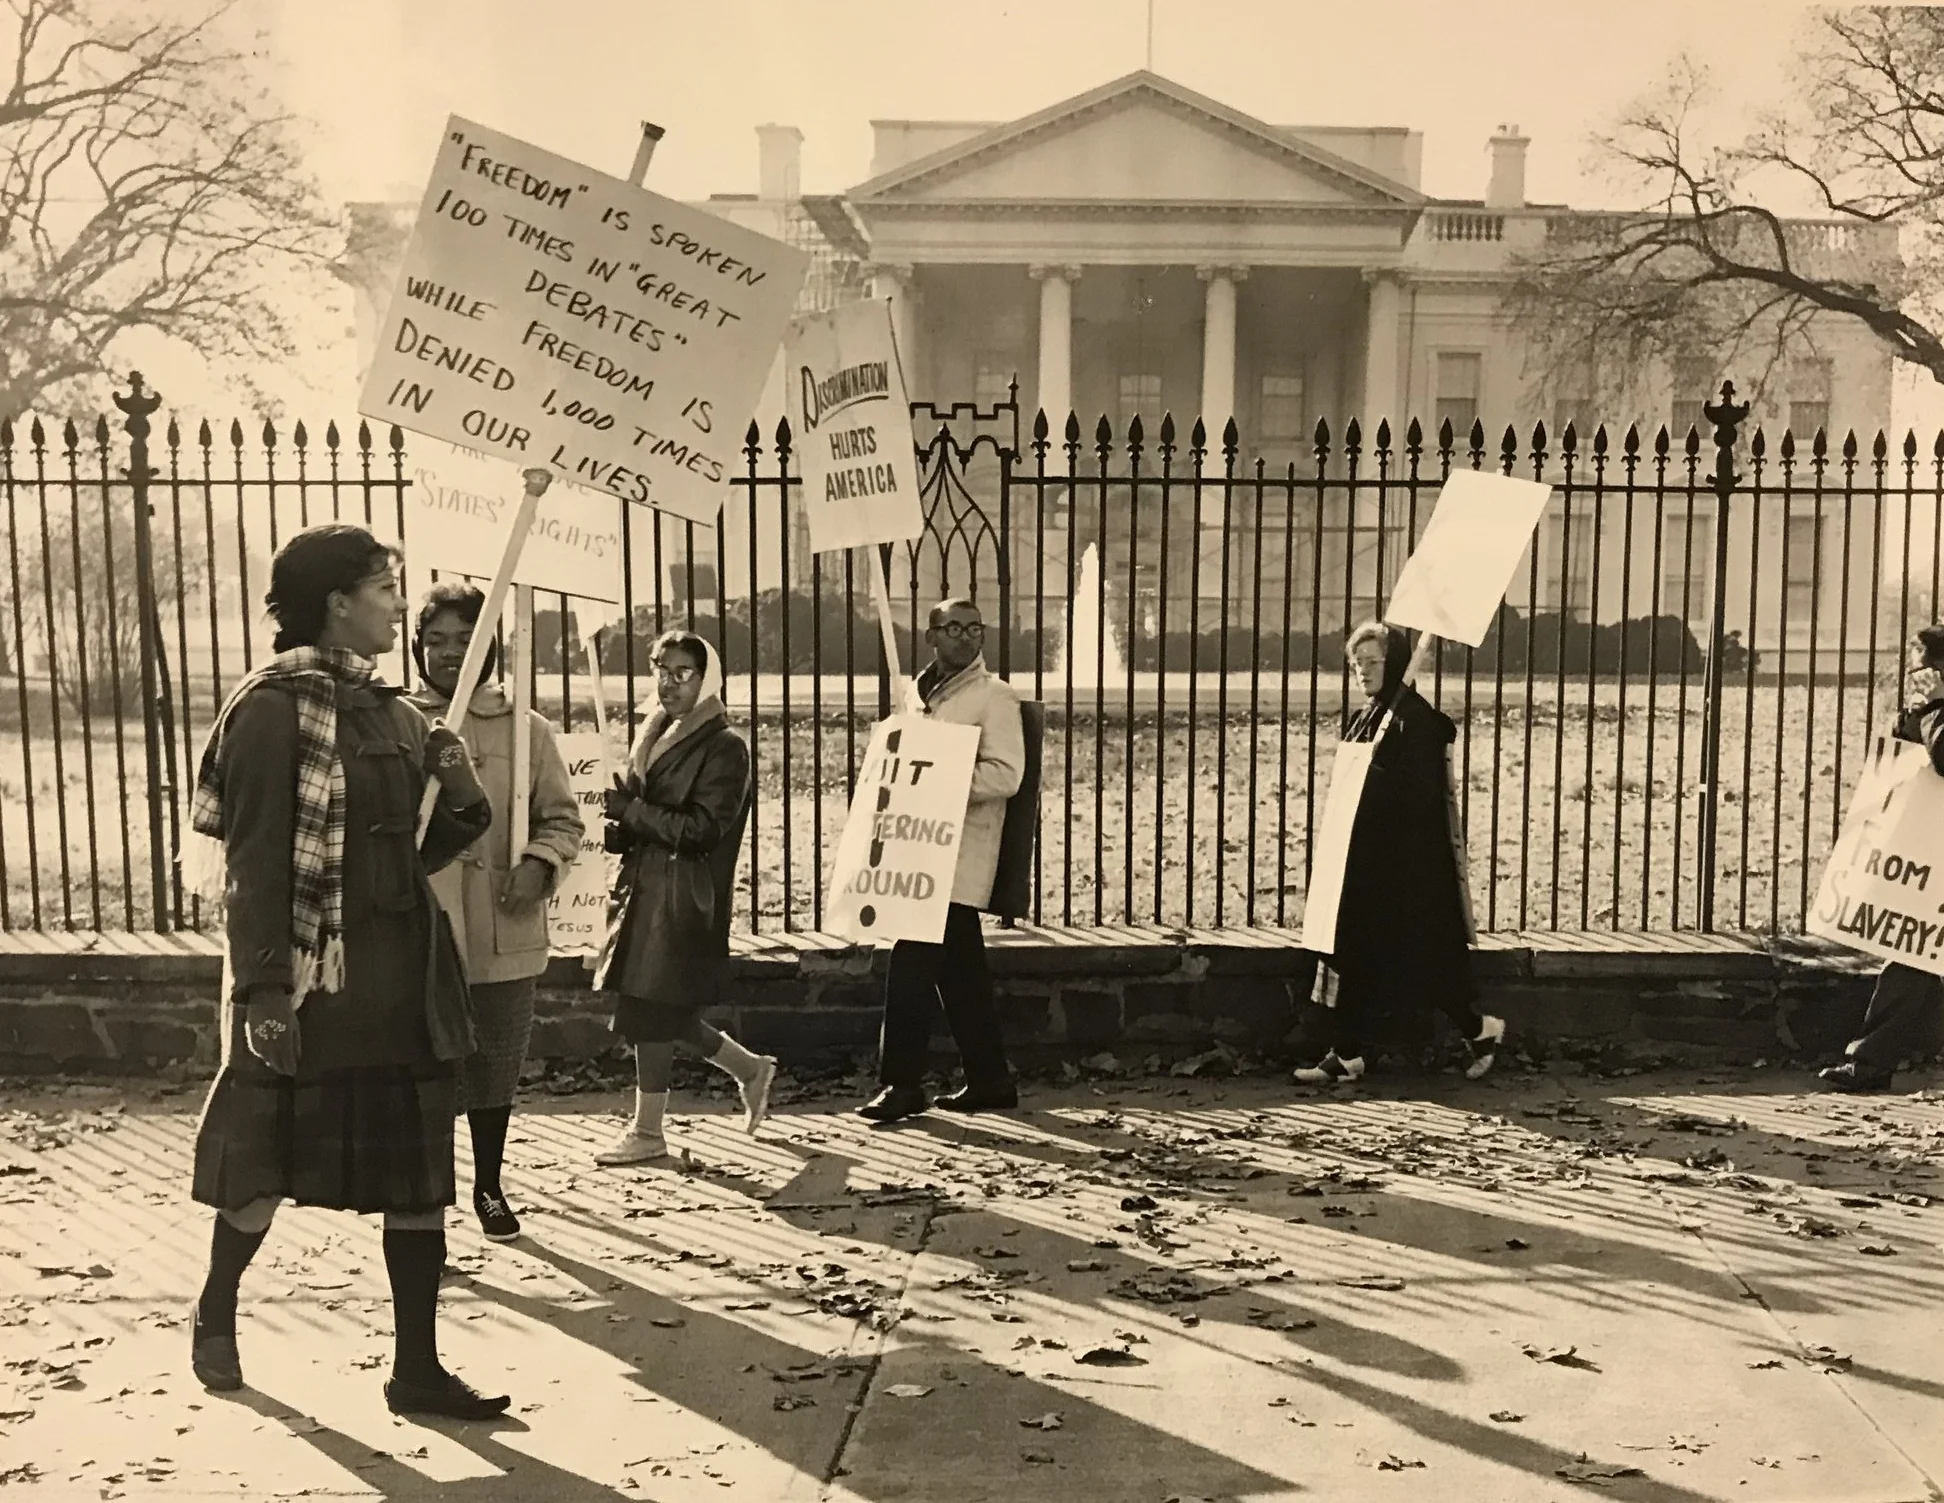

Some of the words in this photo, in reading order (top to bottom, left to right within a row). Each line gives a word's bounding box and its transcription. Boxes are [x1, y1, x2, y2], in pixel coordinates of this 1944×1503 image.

[450, 132, 589, 210] "FREEDOM"
[601, 207, 631, 232] IS
[650, 223, 767, 287] SPOKEN
[435, 189, 487, 227] 100
[503, 214, 576, 263] TIMES
[587, 257, 621, 283] IN
[628, 262, 742, 329] "GREAT
[525, 269, 688, 352] DEBATES"
[406, 276, 498, 322] WHILE
[522, 320, 655, 401] FREEDOM
[681, 397, 714, 434] IS
[394, 318, 516, 392] DENIED
[541, 388, 616, 431] 1,000
[632, 426, 725, 484] TIMES
[801, 361, 889, 433] DISCRIMINATION
[387, 378, 433, 414] IN
[462, 410, 531, 452] OUR
[550, 445, 659, 505] LIVES.
[829, 426, 877, 460] HURTS
[826, 463, 897, 502] AMERICA
[568, 759, 600, 776] VE
[872, 813, 954, 846] TERING
[572, 893, 606, 908] NOT
[847, 869, 935, 900] OUND
